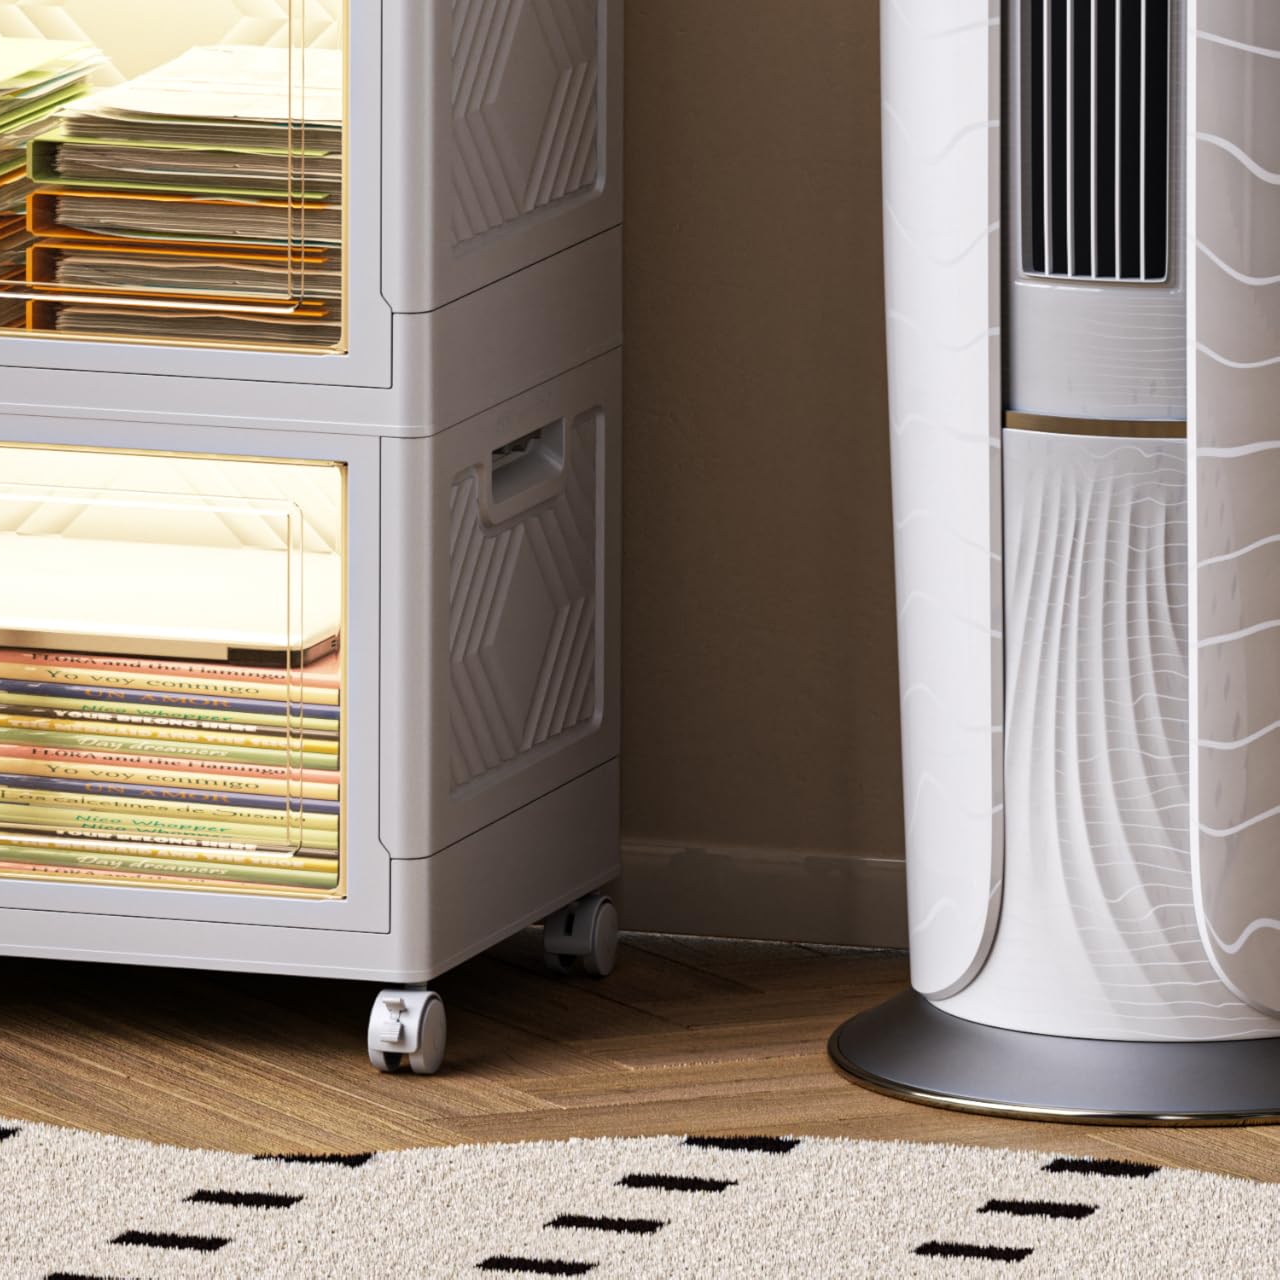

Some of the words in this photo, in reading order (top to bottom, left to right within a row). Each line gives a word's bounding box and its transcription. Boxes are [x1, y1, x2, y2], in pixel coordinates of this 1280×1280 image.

[47, 670, 79, 680] Yo
[90, 675, 136, 685] voy
[146, 679, 260, 694] conmigo
[77, 737, 123, 751] Day
[47, 764, 79, 774] Yo
[90, 770, 135, 780] voy
[146, 775, 260, 789] conmigo
[75, 815, 122, 823] Nico
[131, 819, 233, 833] Whopper
[76, 855, 123, 869] Day
